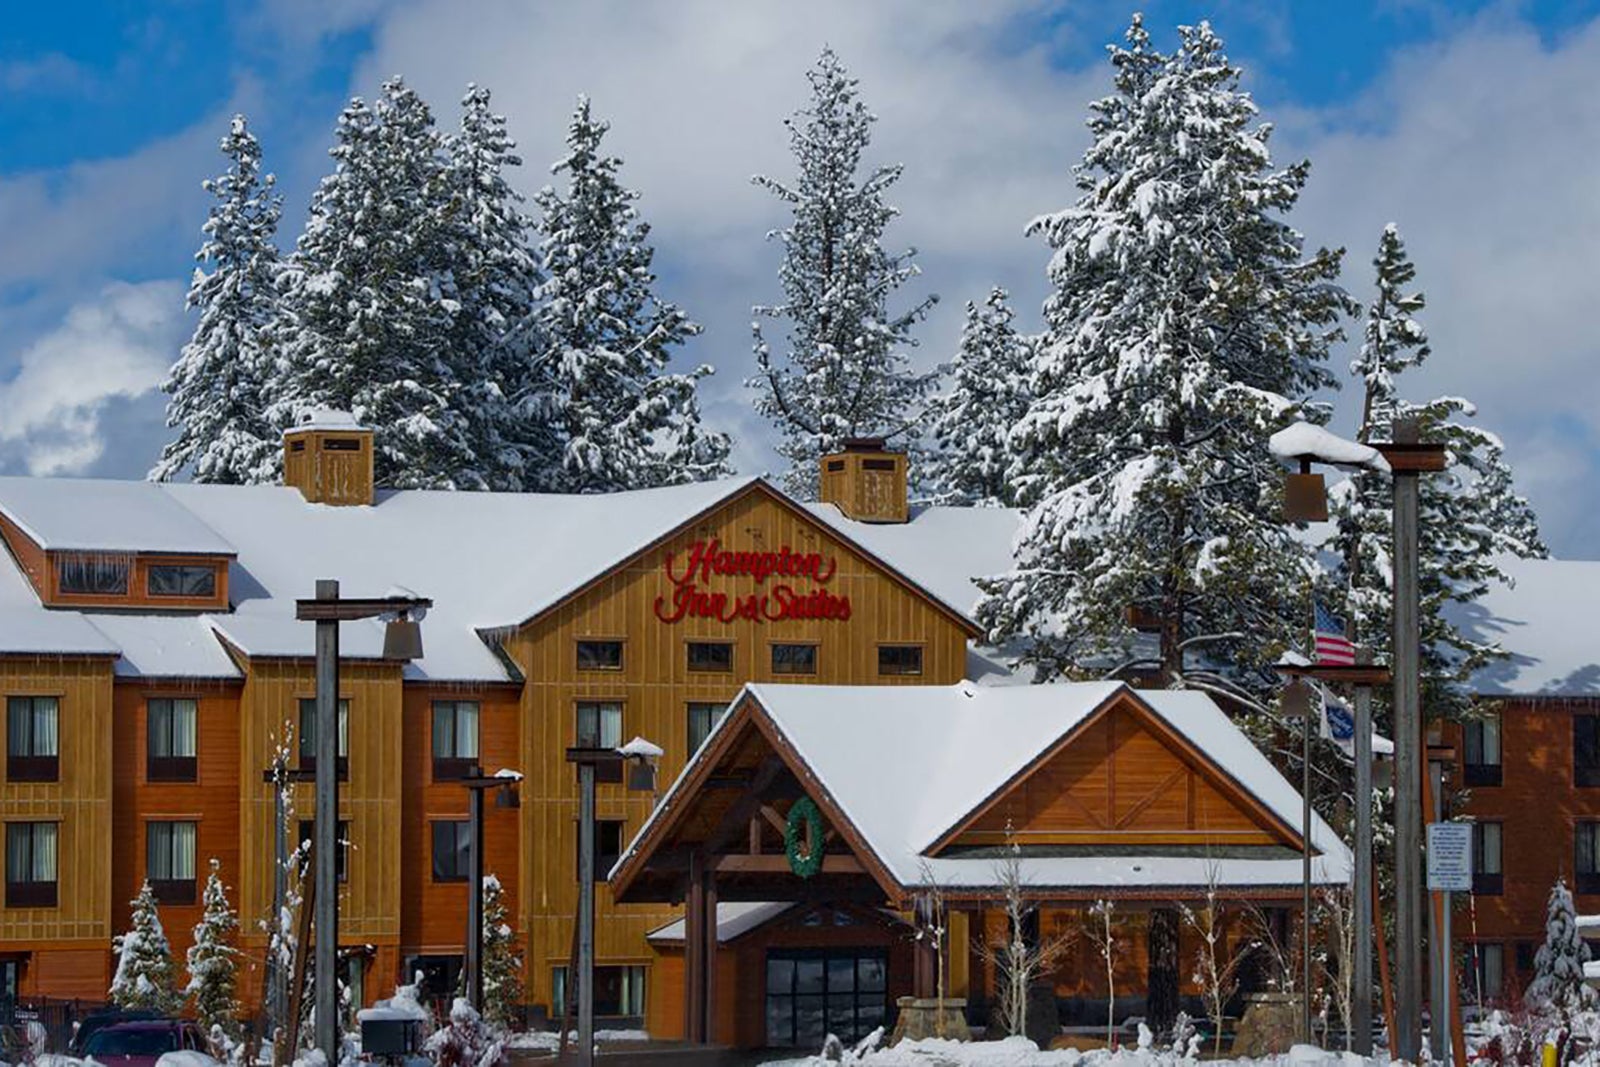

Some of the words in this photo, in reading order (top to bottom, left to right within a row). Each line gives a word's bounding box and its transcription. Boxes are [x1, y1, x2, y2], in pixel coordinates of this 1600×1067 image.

[666, 539, 836, 584] Hampton
[654, 585, 741, 624] Inn
[761, 585, 852, 621] Suites
